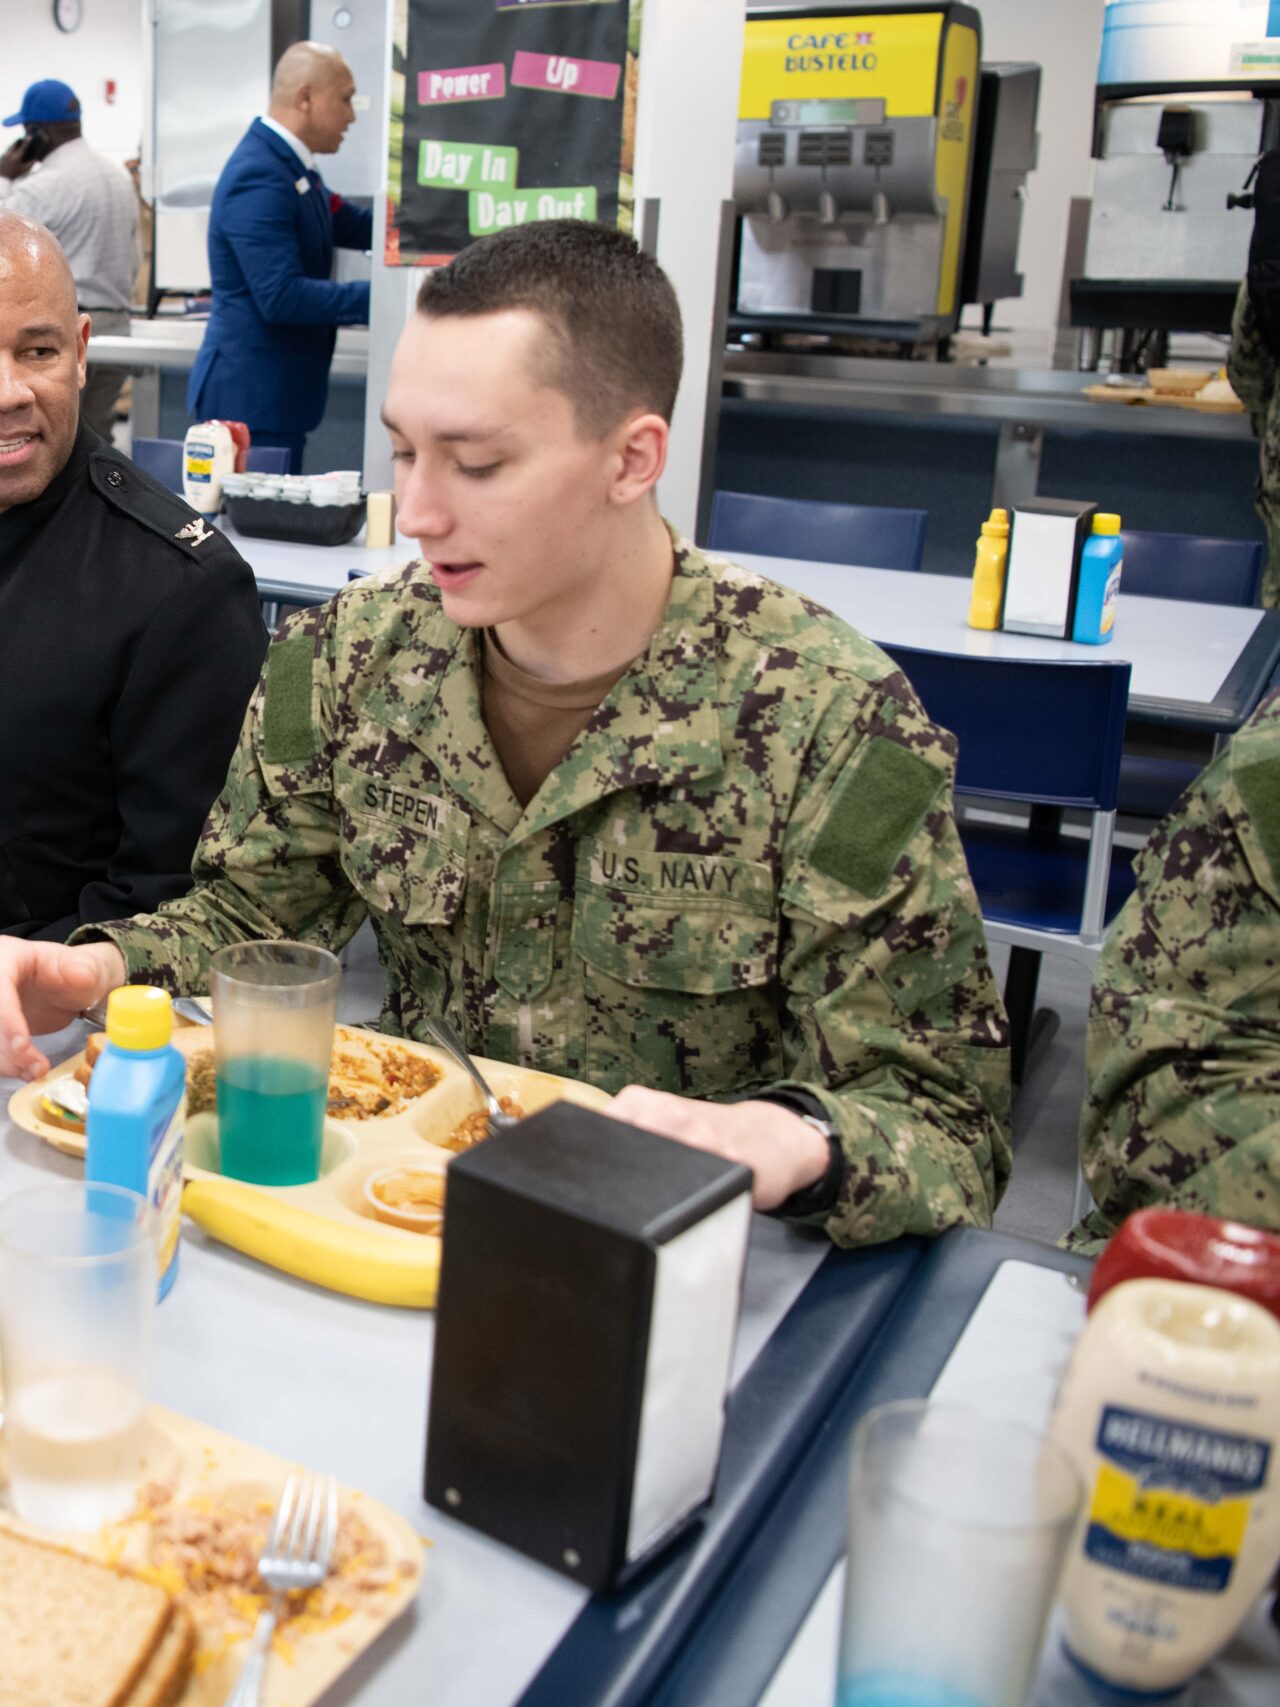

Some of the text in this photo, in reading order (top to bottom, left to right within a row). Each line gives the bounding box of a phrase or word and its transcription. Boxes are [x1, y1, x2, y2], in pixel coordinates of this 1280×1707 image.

[429, 56, 579, 99] Power Up
[785, 51, 878, 72] BUSTELO
[424, 142, 507, 184] Day In
[477, 192, 528, 228] Day
[364, 783, 438, 831] STEPEN
[602, 850, 738, 893] U.S. NAVY
